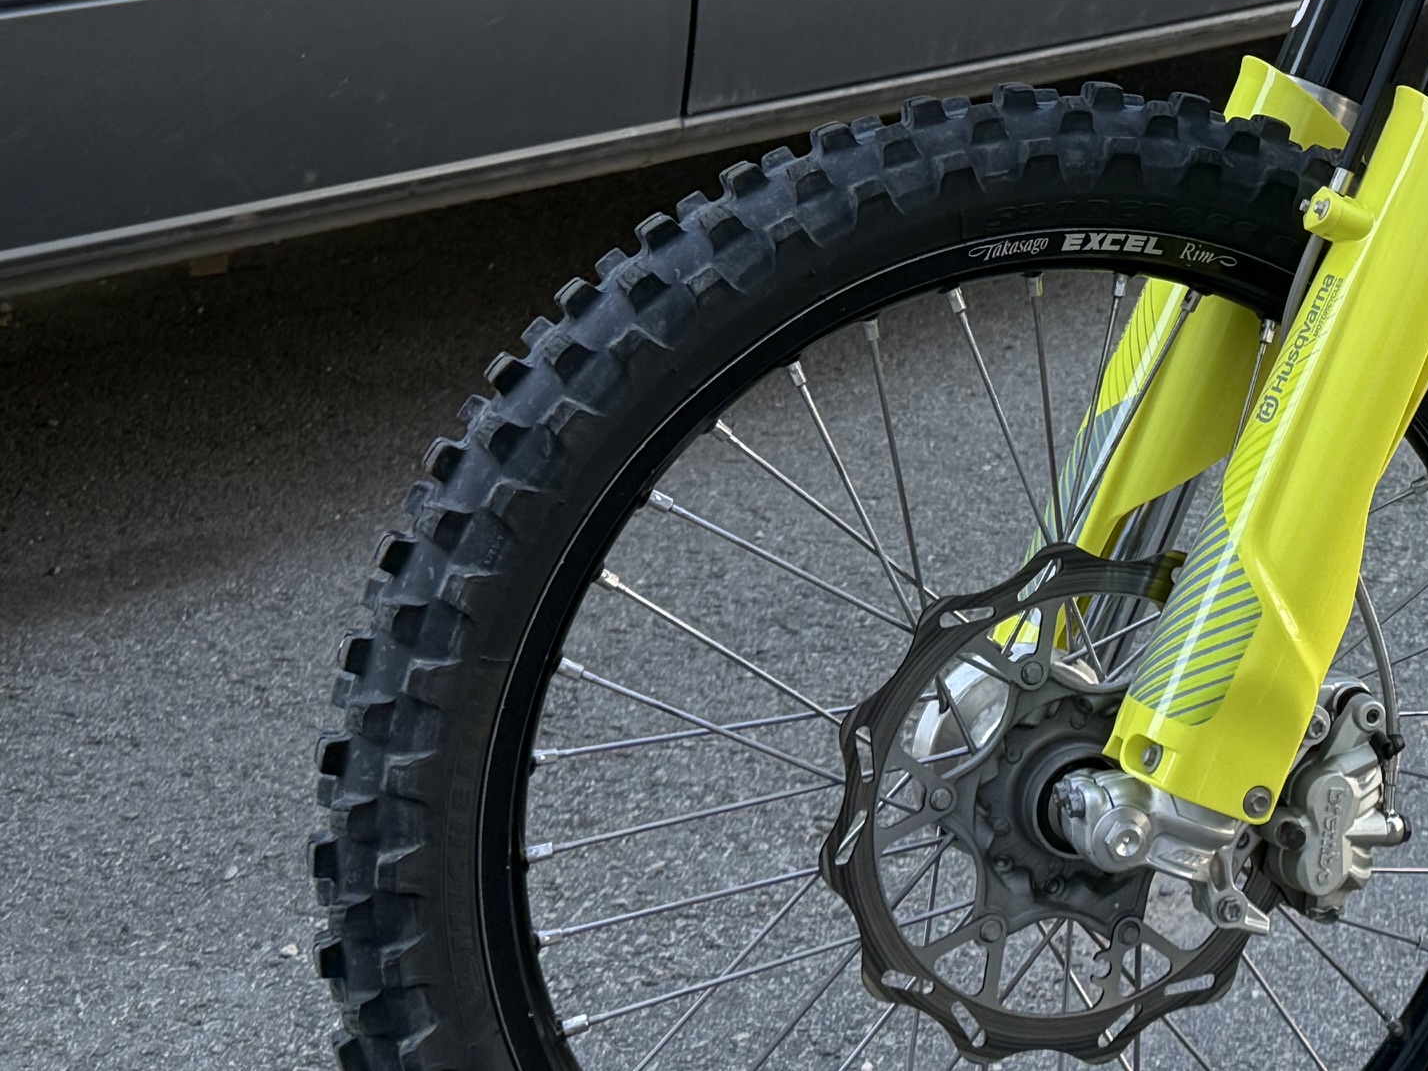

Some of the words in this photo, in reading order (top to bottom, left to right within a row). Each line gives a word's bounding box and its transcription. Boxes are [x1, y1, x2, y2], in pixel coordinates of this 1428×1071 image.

[967, 236, 1050, 263] Takasago
[1060, 232, 1164, 257] EXCEL
[1179, 242, 1238, 268] Rim
[1271, 273, 1335, 394] Husqvarna
[1316, 786, 1344, 886] brembo
